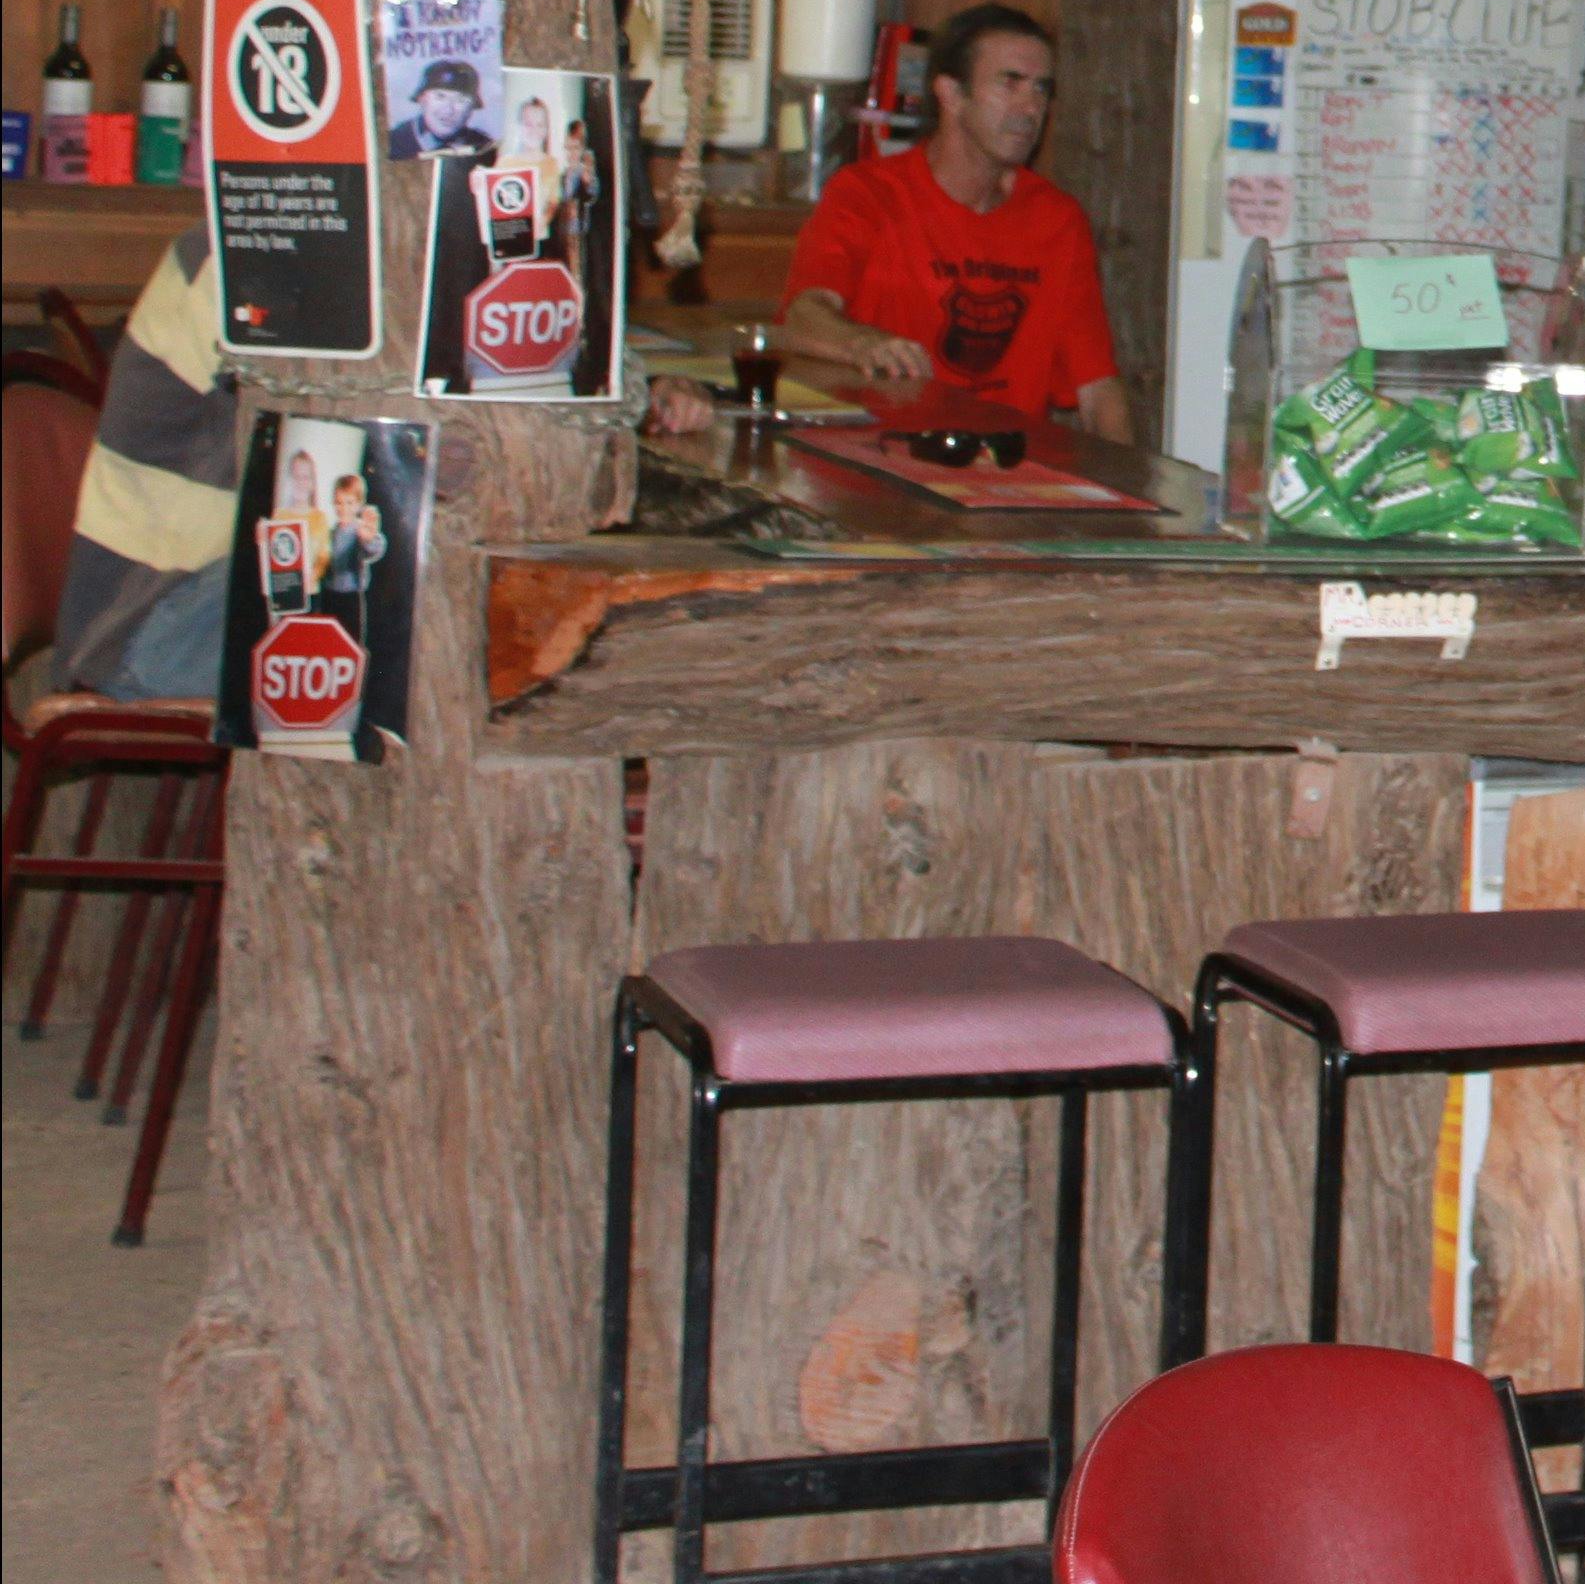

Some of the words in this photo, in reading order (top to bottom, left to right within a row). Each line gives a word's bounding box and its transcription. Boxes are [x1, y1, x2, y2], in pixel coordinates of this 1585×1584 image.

[251, 44, 313, 116] 18
[480, 301, 578, 346] STOP
[262, 656, 354, 701] STOP
